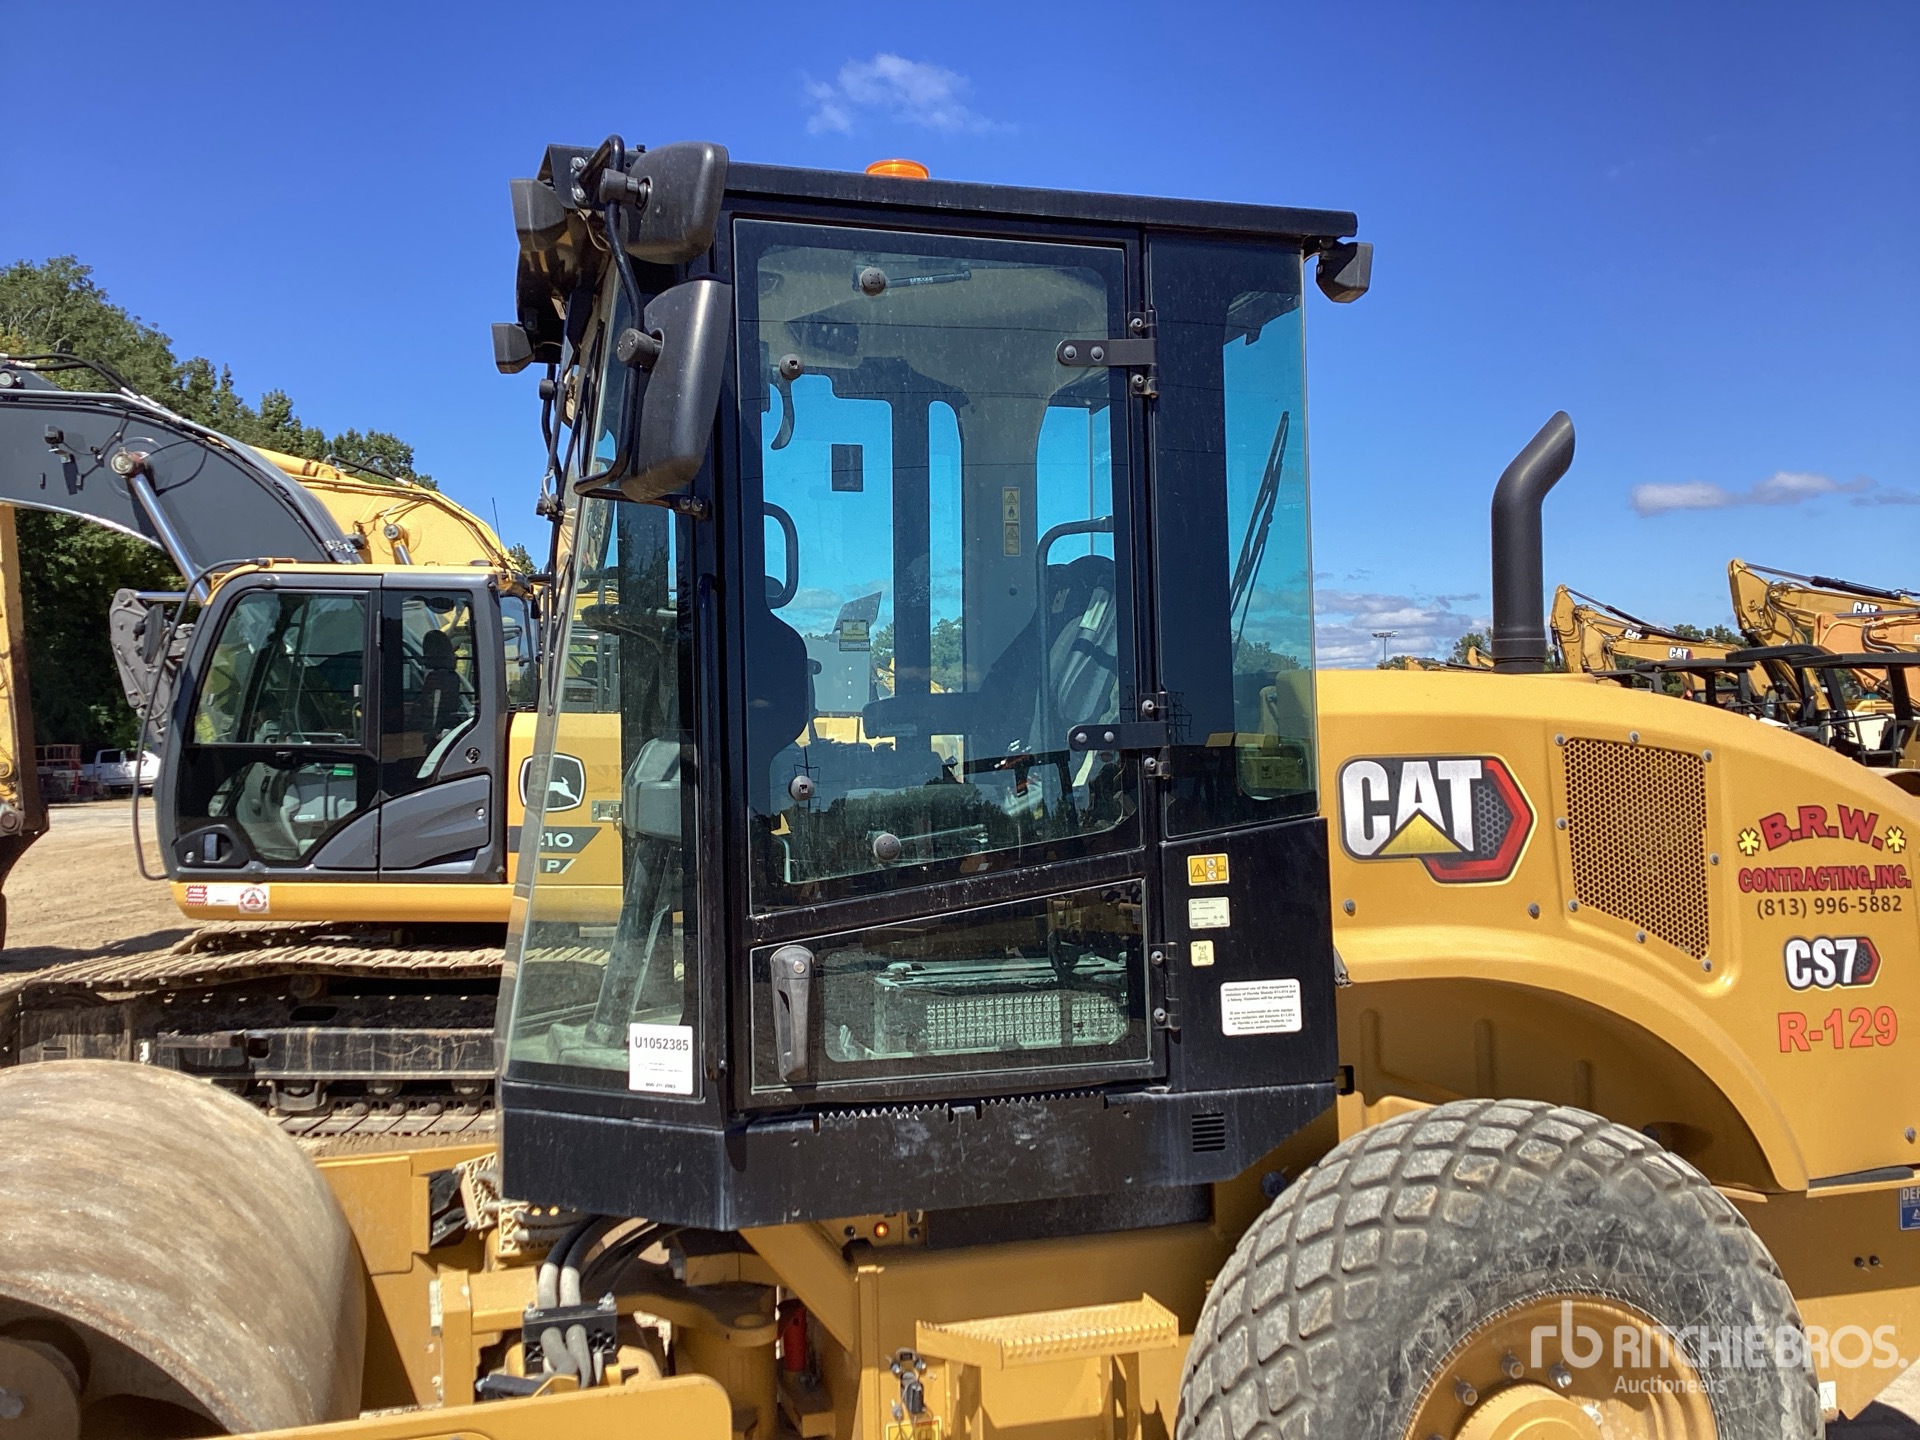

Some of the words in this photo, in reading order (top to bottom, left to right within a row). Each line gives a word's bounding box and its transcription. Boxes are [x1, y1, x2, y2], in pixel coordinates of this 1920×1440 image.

[1853, 602, 1878, 614] CAT
[1625, 628, 1642, 640] CAT
[1669, 647, 1689, 660] CAT
[1342, 759, 1483, 856] CAT
[1759, 803, 1884, 852] B.R.W.
[1757, 897, 1807, 920] (813)
[1814, 895, 1903, 915] 996-5882
[1785, 938, 1858, 988] CS7
[1777, 1005, 1898, 1054] R-129
[634, 1036, 689, 1051] U1052385
